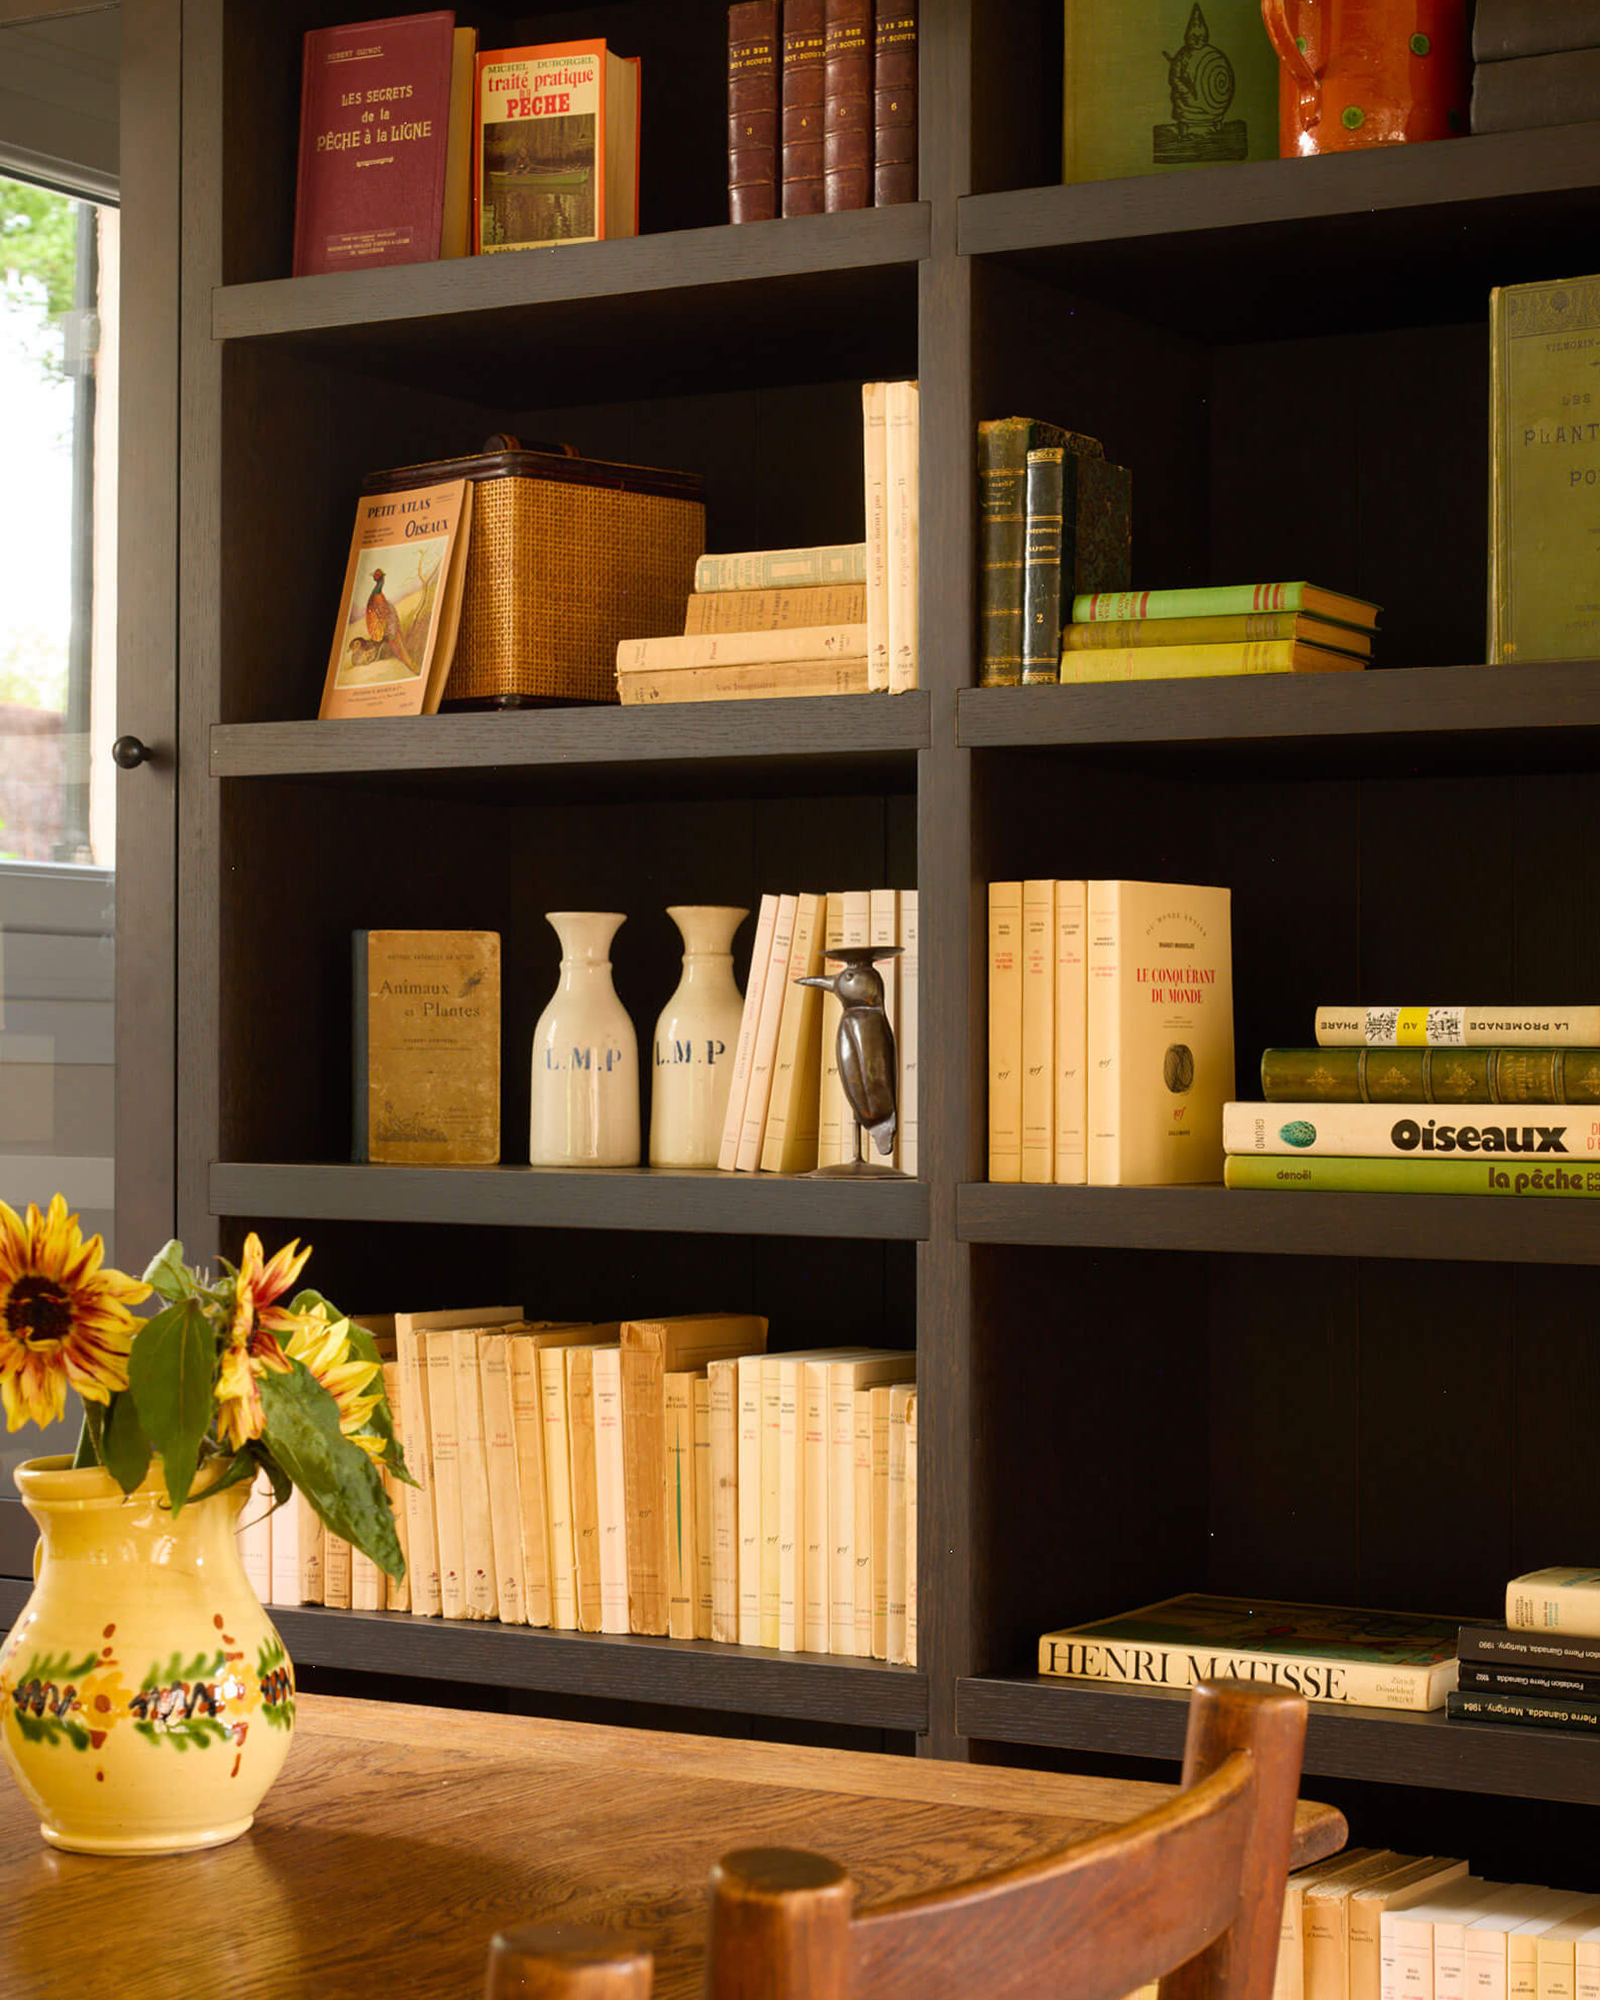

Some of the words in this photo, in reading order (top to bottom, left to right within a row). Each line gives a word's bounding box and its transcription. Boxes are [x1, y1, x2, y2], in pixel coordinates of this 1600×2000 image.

[488, 63, 528, 74] MICHEL
[488, 71, 529, 92] traité
[534, 68, 594, 92] pratique
[341, 92, 362, 107] LES
[366, 84, 414, 103] SECRETS
[361, 111, 374, 123] de
[380, 108, 390, 120] la
[316, 130, 361, 152] PÊCHE
[364, 128, 371, 144] à
[376, 128, 387, 143] la
[390, 120, 432, 142] LIGNE
[368, 504, 396, 519] PETIT
[399, 498, 431, 514] ATLAS
[1036, 613, 1044, 623] 2
[1137, 967, 1149, 982] LE
[1151, 964, 1216, 987] CONQUÉRANT
[379, 979, 449, 995] Animaux
[1151, 988, 1163, 1003] DU
[1168, 988, 1203, 1004] MONDE
[423, 1001, 480, 1017] Plantes
[1320, 1021, 1358, 1030] PHARE
[1402, 1022, 1418, 1030] AU
[1470, 1021, 1550, 1031] PROMENADE
[1554, 1022, 1569, 1031] LA
[1390, 1118, 1570, 1153] Oiseaux
[1276, 1169, 1312, 1181] denoël
[1489, 1166, 1511, 1189] la
[1515, 1168, 1584, 1194] pêche
[1564, 1648, 1584, 1659] Pierre
[1048, 1642, 1170, 1683] HENRI
[1187, 1655, 1348, 1701] MATISSE
[1497, 1675, 1529, 1685] Gianadda
[1530, 1677, 1550, 1687] Pierre
[1551, 1680, 1584, 1690] Fondation
[1463, 1703, 1482, 1712] 1984
[1526, 1708, 1568, 1721] Gianadda,
[1571, 1713, 1597, 1724] Pierre
